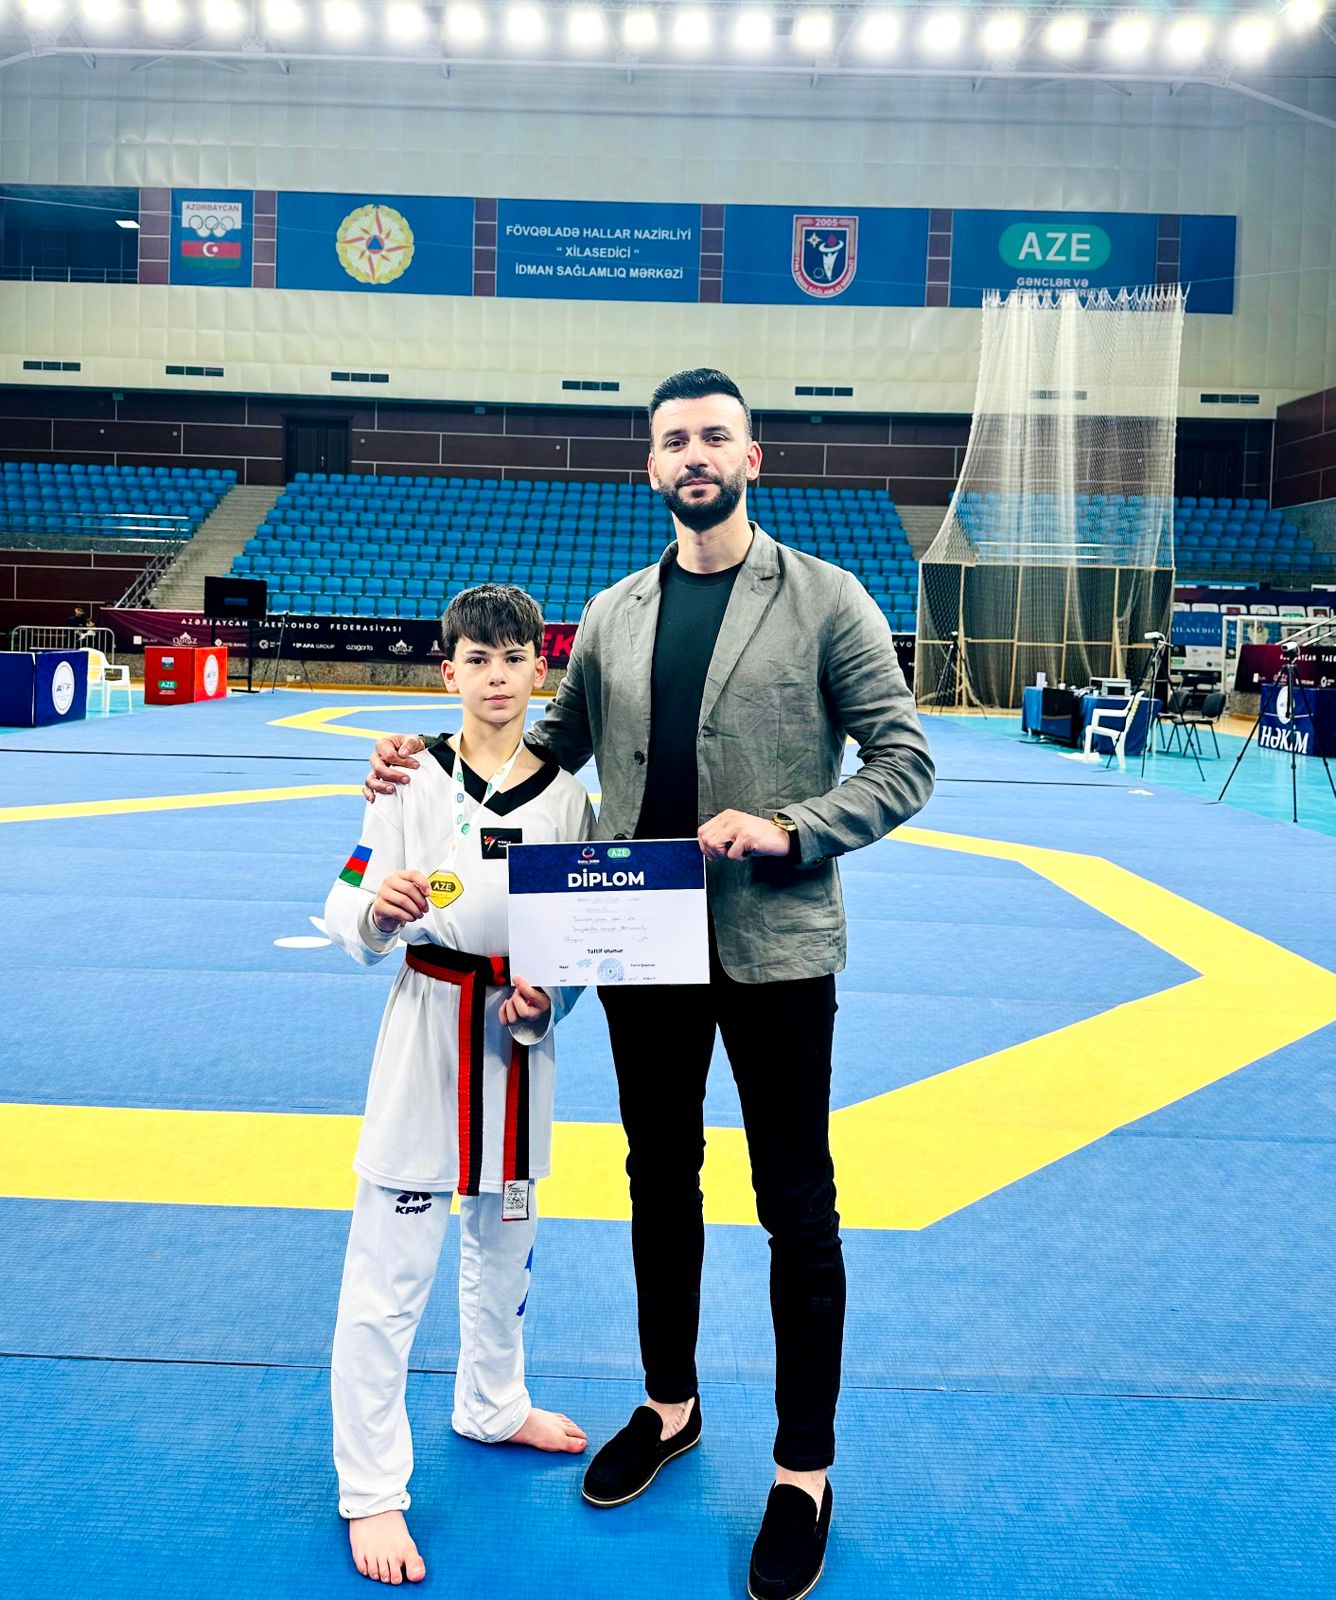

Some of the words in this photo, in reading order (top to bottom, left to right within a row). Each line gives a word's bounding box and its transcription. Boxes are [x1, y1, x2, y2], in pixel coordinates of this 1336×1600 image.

[815, 218, 839, 227] 2005
[506, 224, 580, 238] FÖVQƏLADƏ
[583, 227, 631, 239] HALLAR
[634, 227, 692, 241] NAZİRLİYİ
[565, 244, 631, 259] XİLASEDİCİ
[1018, 231, 1091, 262] AZE
[515, 262, 554, 276] İDMAN
[556, 263, 627, 279] SAĞLAMLIQ
[629, 266, 684, 280] MƏRKƏZİ
[1016, 276, 1072, 288] GƏNCLƏR
[1073, 278, 1089, 288] VƏ
[330, 623, 402, 633] FEDERASİYASI
[567, 868, 645, 888] DİPLOM
[433, 881, 453, 892] AZE
[395, 1202, 433, 1215] KPNP
